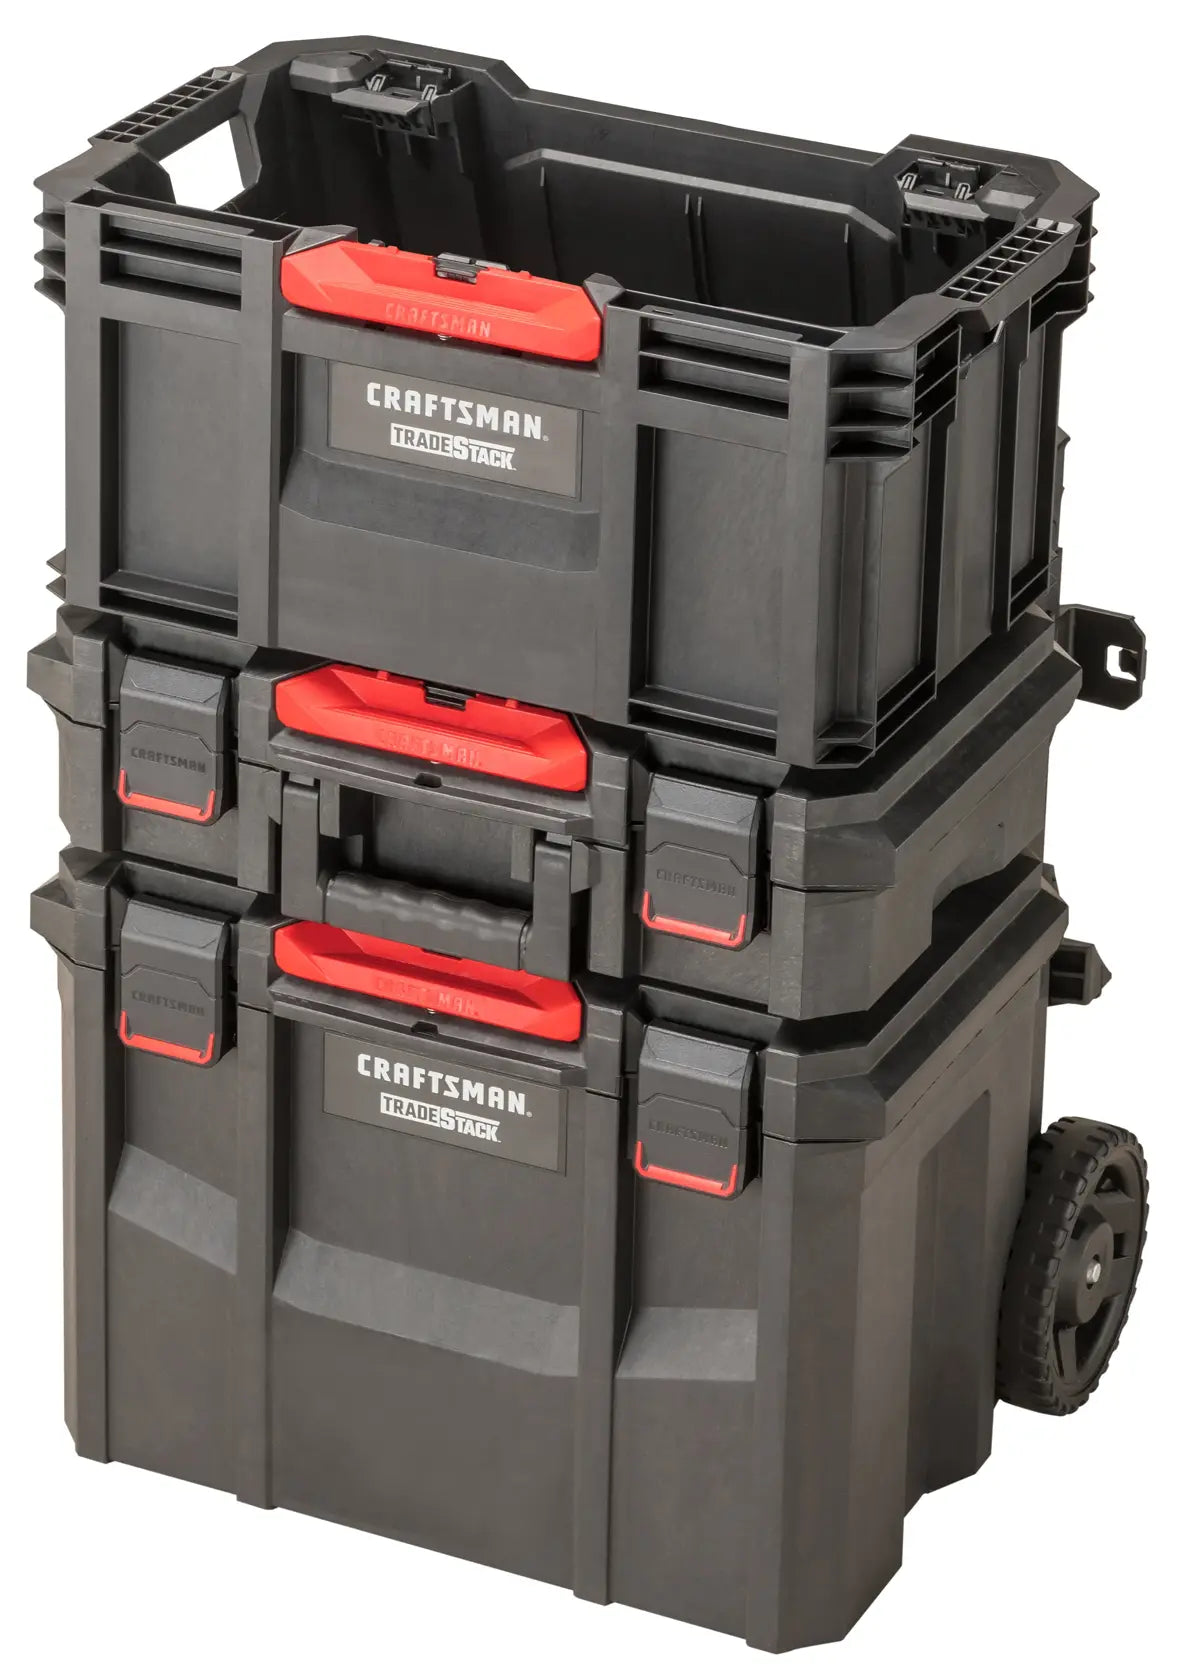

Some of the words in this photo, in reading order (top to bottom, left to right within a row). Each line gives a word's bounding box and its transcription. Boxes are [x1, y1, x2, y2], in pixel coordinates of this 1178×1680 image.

[384, 303, 491, 337] CRAFTSMAN
[131, 747, 206, 773] CRAFTSMAN
[376, 729, 480, 768] ATMAN
[376, 977, 476, 1016] CAFTMAN
